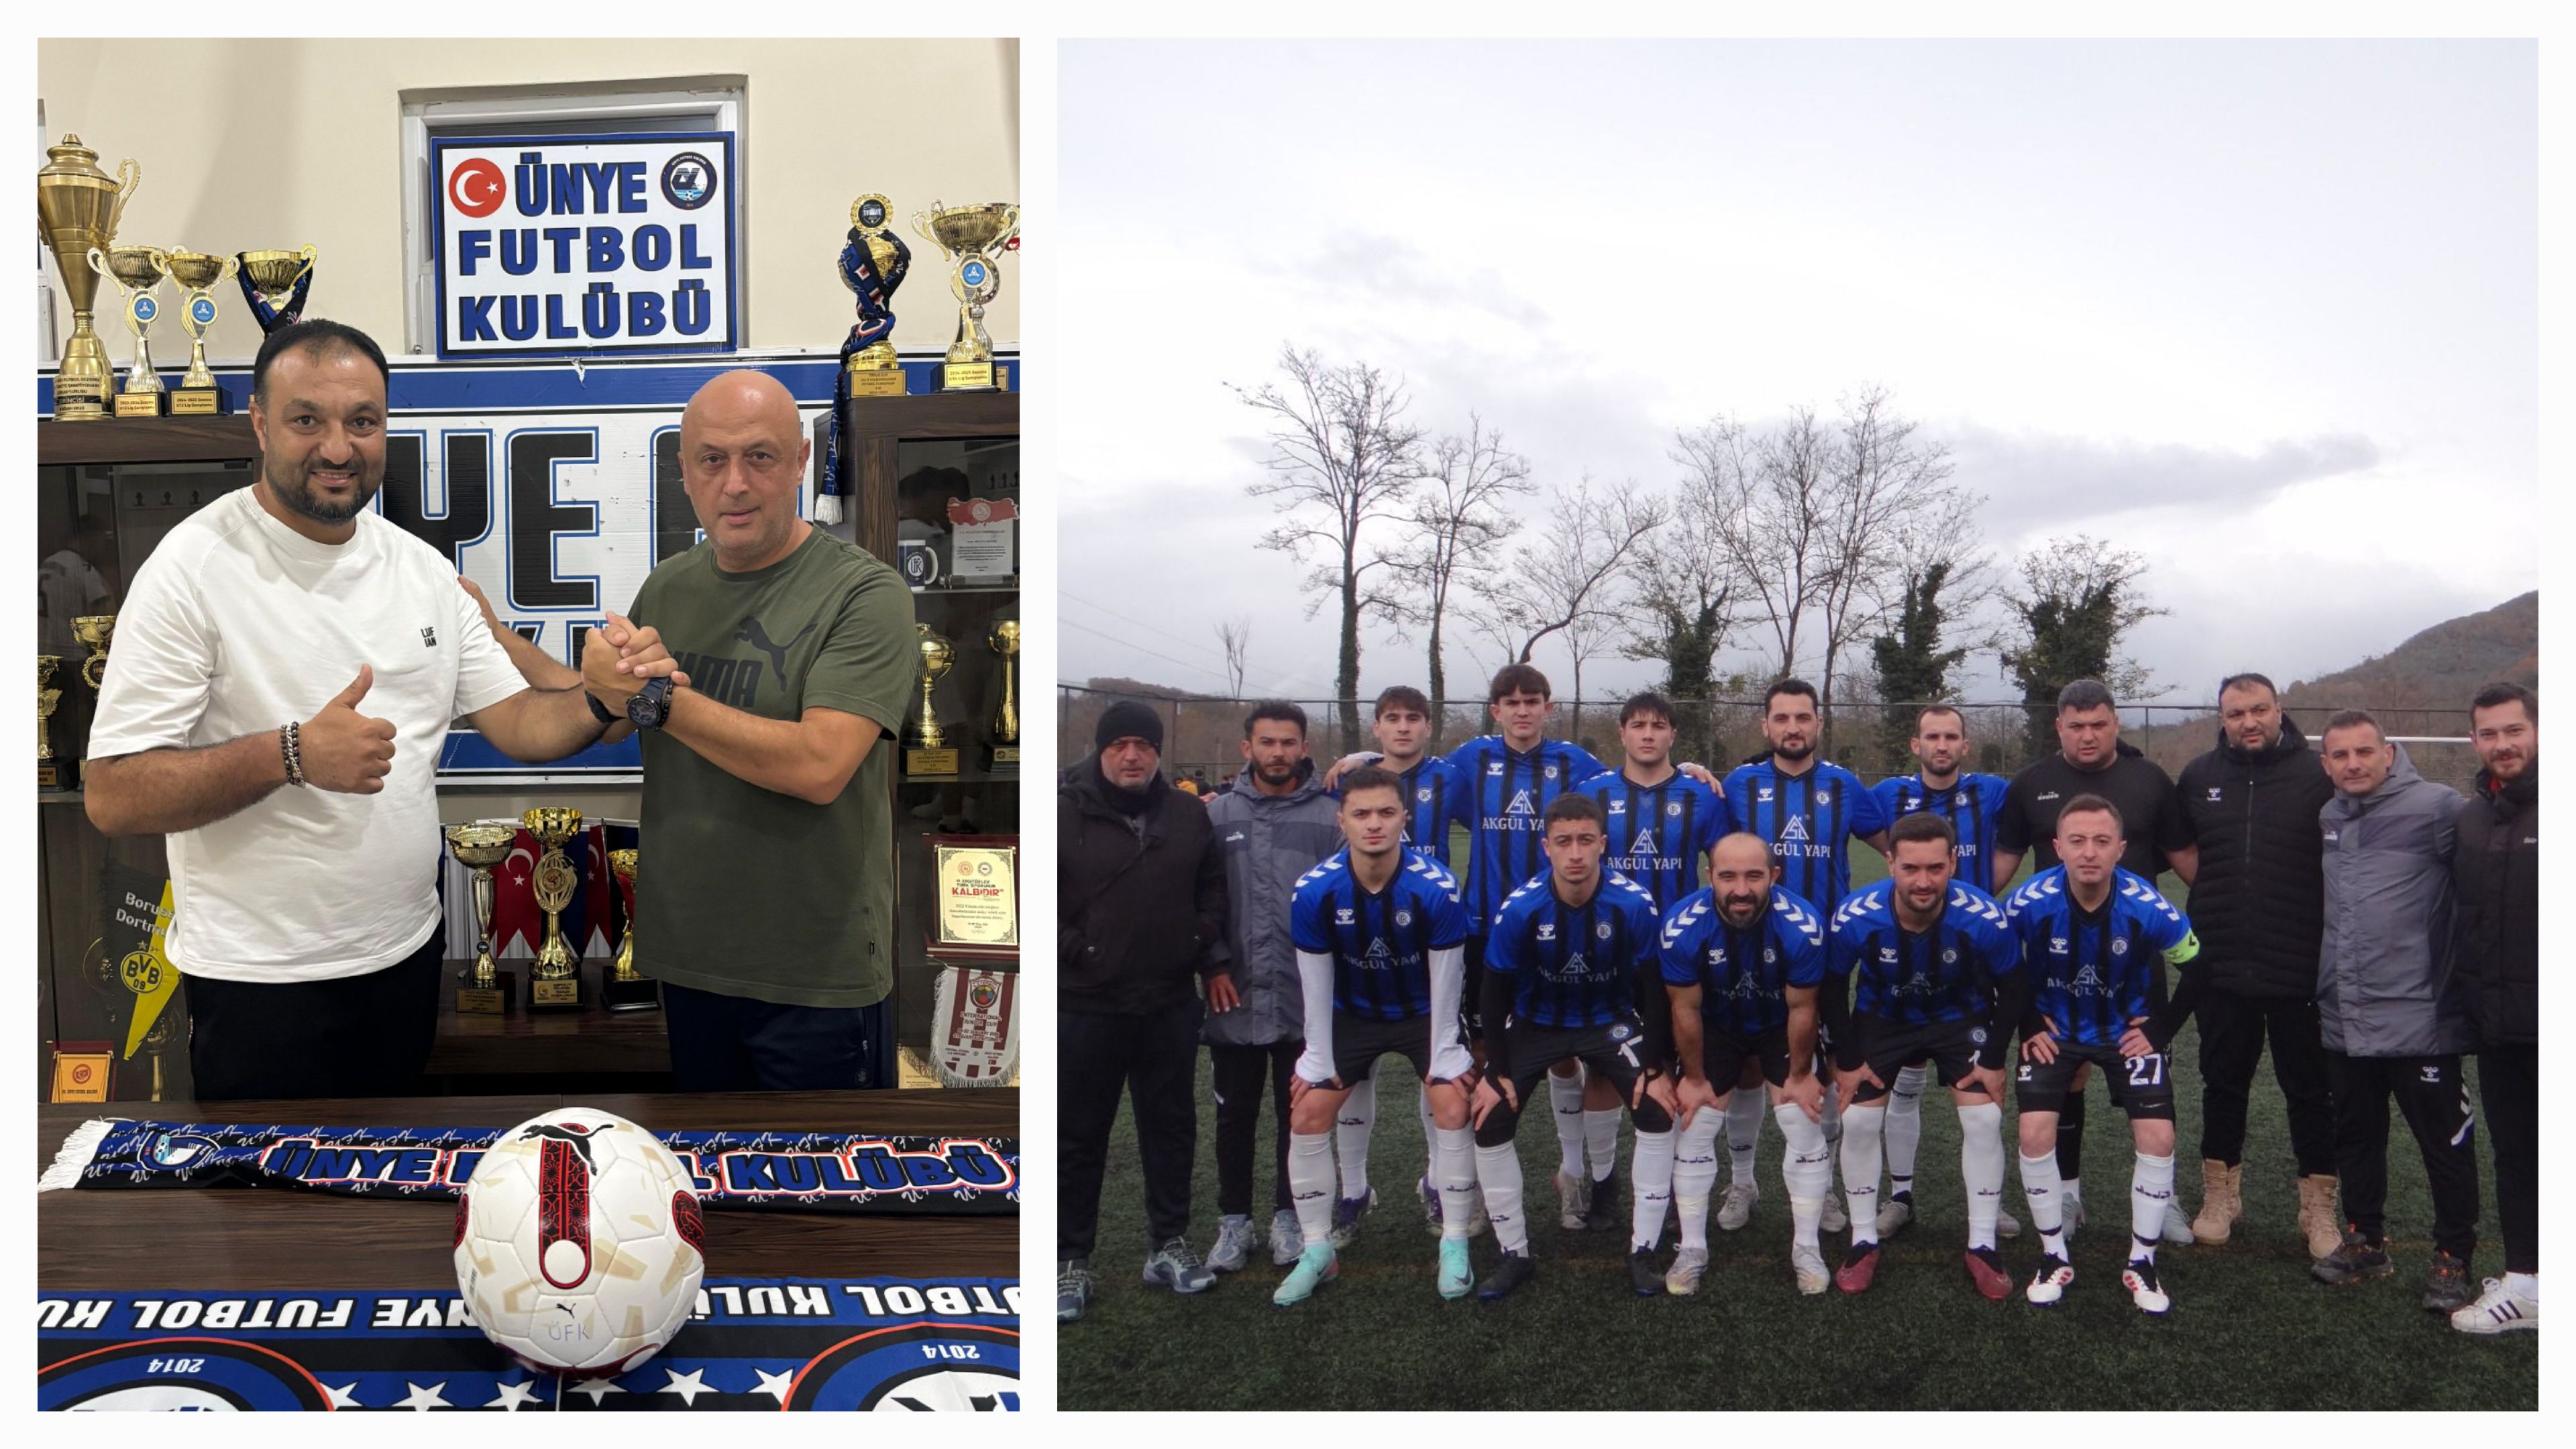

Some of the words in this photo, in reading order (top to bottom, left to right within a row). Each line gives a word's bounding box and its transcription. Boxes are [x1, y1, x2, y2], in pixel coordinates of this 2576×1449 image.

[515, 152, 647, 217] ÜNYE
[459, 224, 712, 276] FUTBOL
[460, 279, 710, 341] KULÜBÜ
[1482, 815, 1526, 830] AKGÜL
[1529, 818, 1544, 830] YA
[1607, 855, 1650, 870] AKGÜL
[1653, 857, 1682, 870] YAPI
[1770, 841, 1801, 857] GÜL
[1804, 845, 1831, 858] YAPI
[125, 892, 176, 919] Boruss
[115, 908, 168, 937] Dortmu
[126, 955, 160, 984] BVB
[133, 979, 146, 990] 09
[2126, 1054, 2161, 1085] 27
[267, 1138, 437, 1184] ÜNYE
[724, 1144, 1010, 1193] KULÜBÜ
[134, 1300, 352, 1328] FUTBOL
[147, 1358, 205, 1373] 2014
[922, 1344, 980, 1359] 2014
